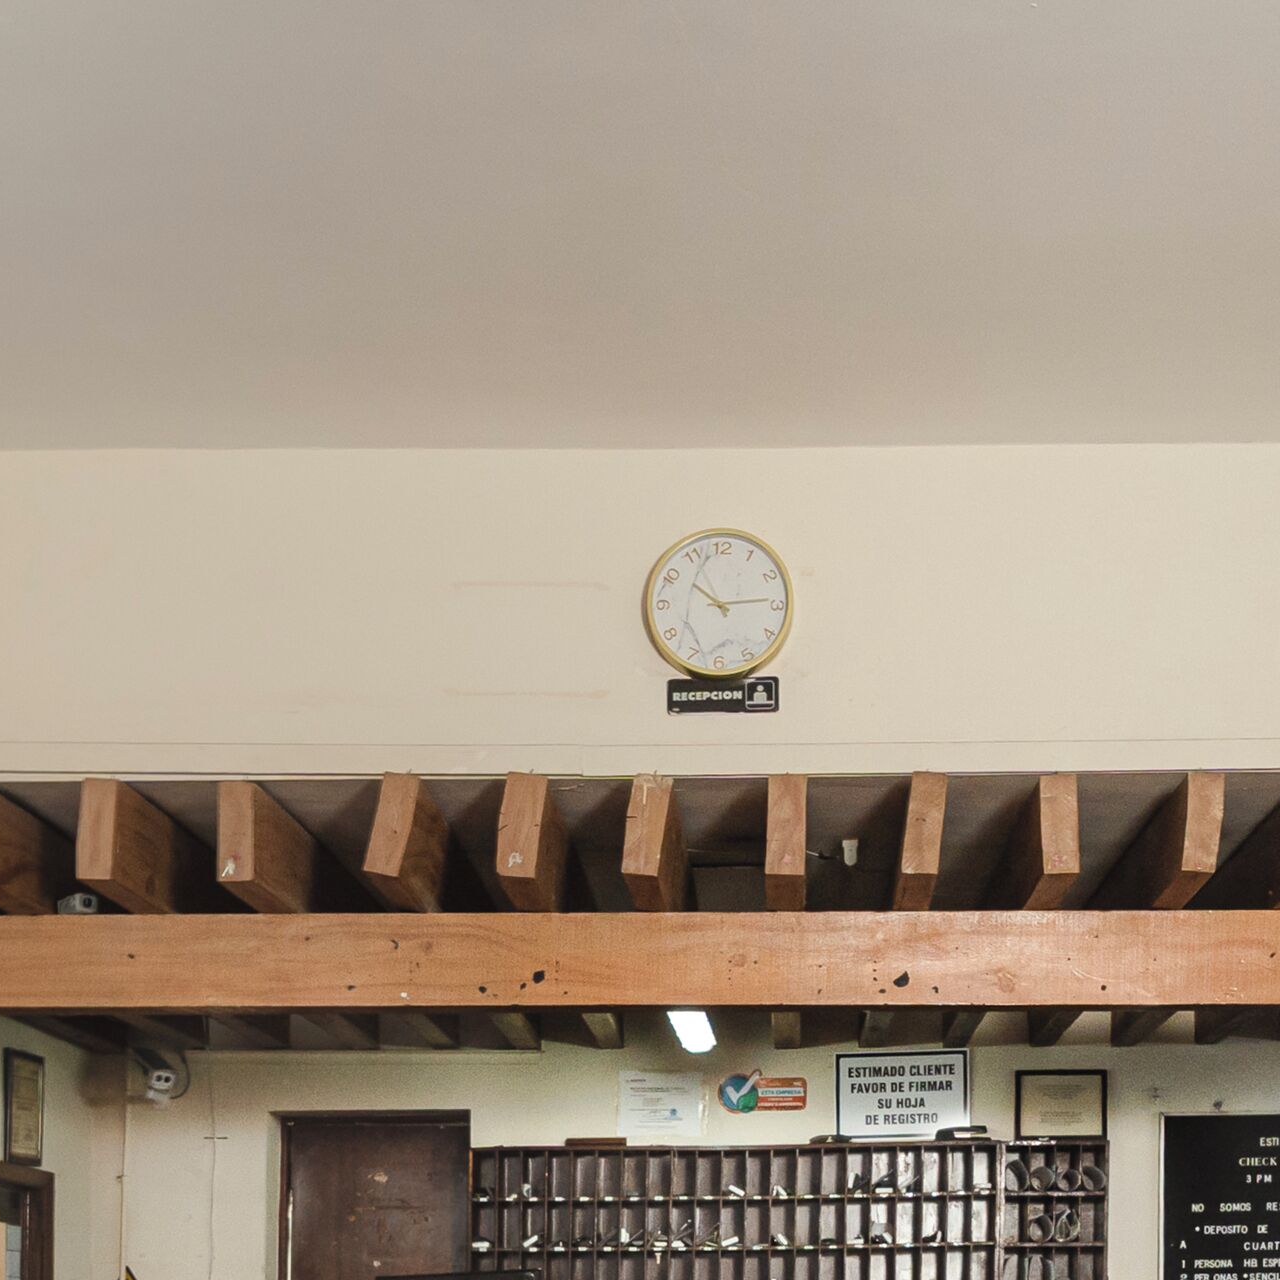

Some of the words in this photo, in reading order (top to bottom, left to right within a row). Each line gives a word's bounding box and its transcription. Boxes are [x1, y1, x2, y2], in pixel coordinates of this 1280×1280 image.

[712, 542, 732, 555] 12
[682, 548, 702, 564] 11
[745, 550, 754, 562] 1
[663, 568, 680, 585] 10
[762, 569, 777, 583] 2
[656, 600, 670, 610] 9
[770, 600, 784, 612] 3
[664, 627, 677, 640] 8
[763, 628, 776, 640] 4
[687, 646, 700, 660] 7
[741, 648, 754, 662] 5
[713, 656, 724, 670] 6
[672, 690, 742, 701] RECEPCION
[848, 1066, 905, 1078] ESTIMADO
[910, 1064, 956, 1076] CLIENTE
[850, 1082, 886, 1094] FAVOR
[891, 1082, 905, 1092] DE
[909, 1080, 952, 1092] FIRMAR
[878, 1098, 892, 1109] SU
[896, 1098, 925, 1108] HOJA
[865, 1114, 879, 1125] DE
[884, 1113, 938, 1125] REGISTRO
[1238, 1157, 1277, 1166] CHECK
[1246, 1174, 1252, 1183] 3
[1192, 1203, 1205, 1212] NO
[1220, 1203, 1252, 1212] SOMOS
[1204, 1225, 1248, 1235] DEPOSITO
[1257, 1225, 1268, 1234] DE
[1180, 1240, 1186, 1249] A
[1182, 1260, 1186, 1268] 1
[1194, 1259, 1233, 1268] PERSONA
[1244, 1258, 1258, 1267] HB
